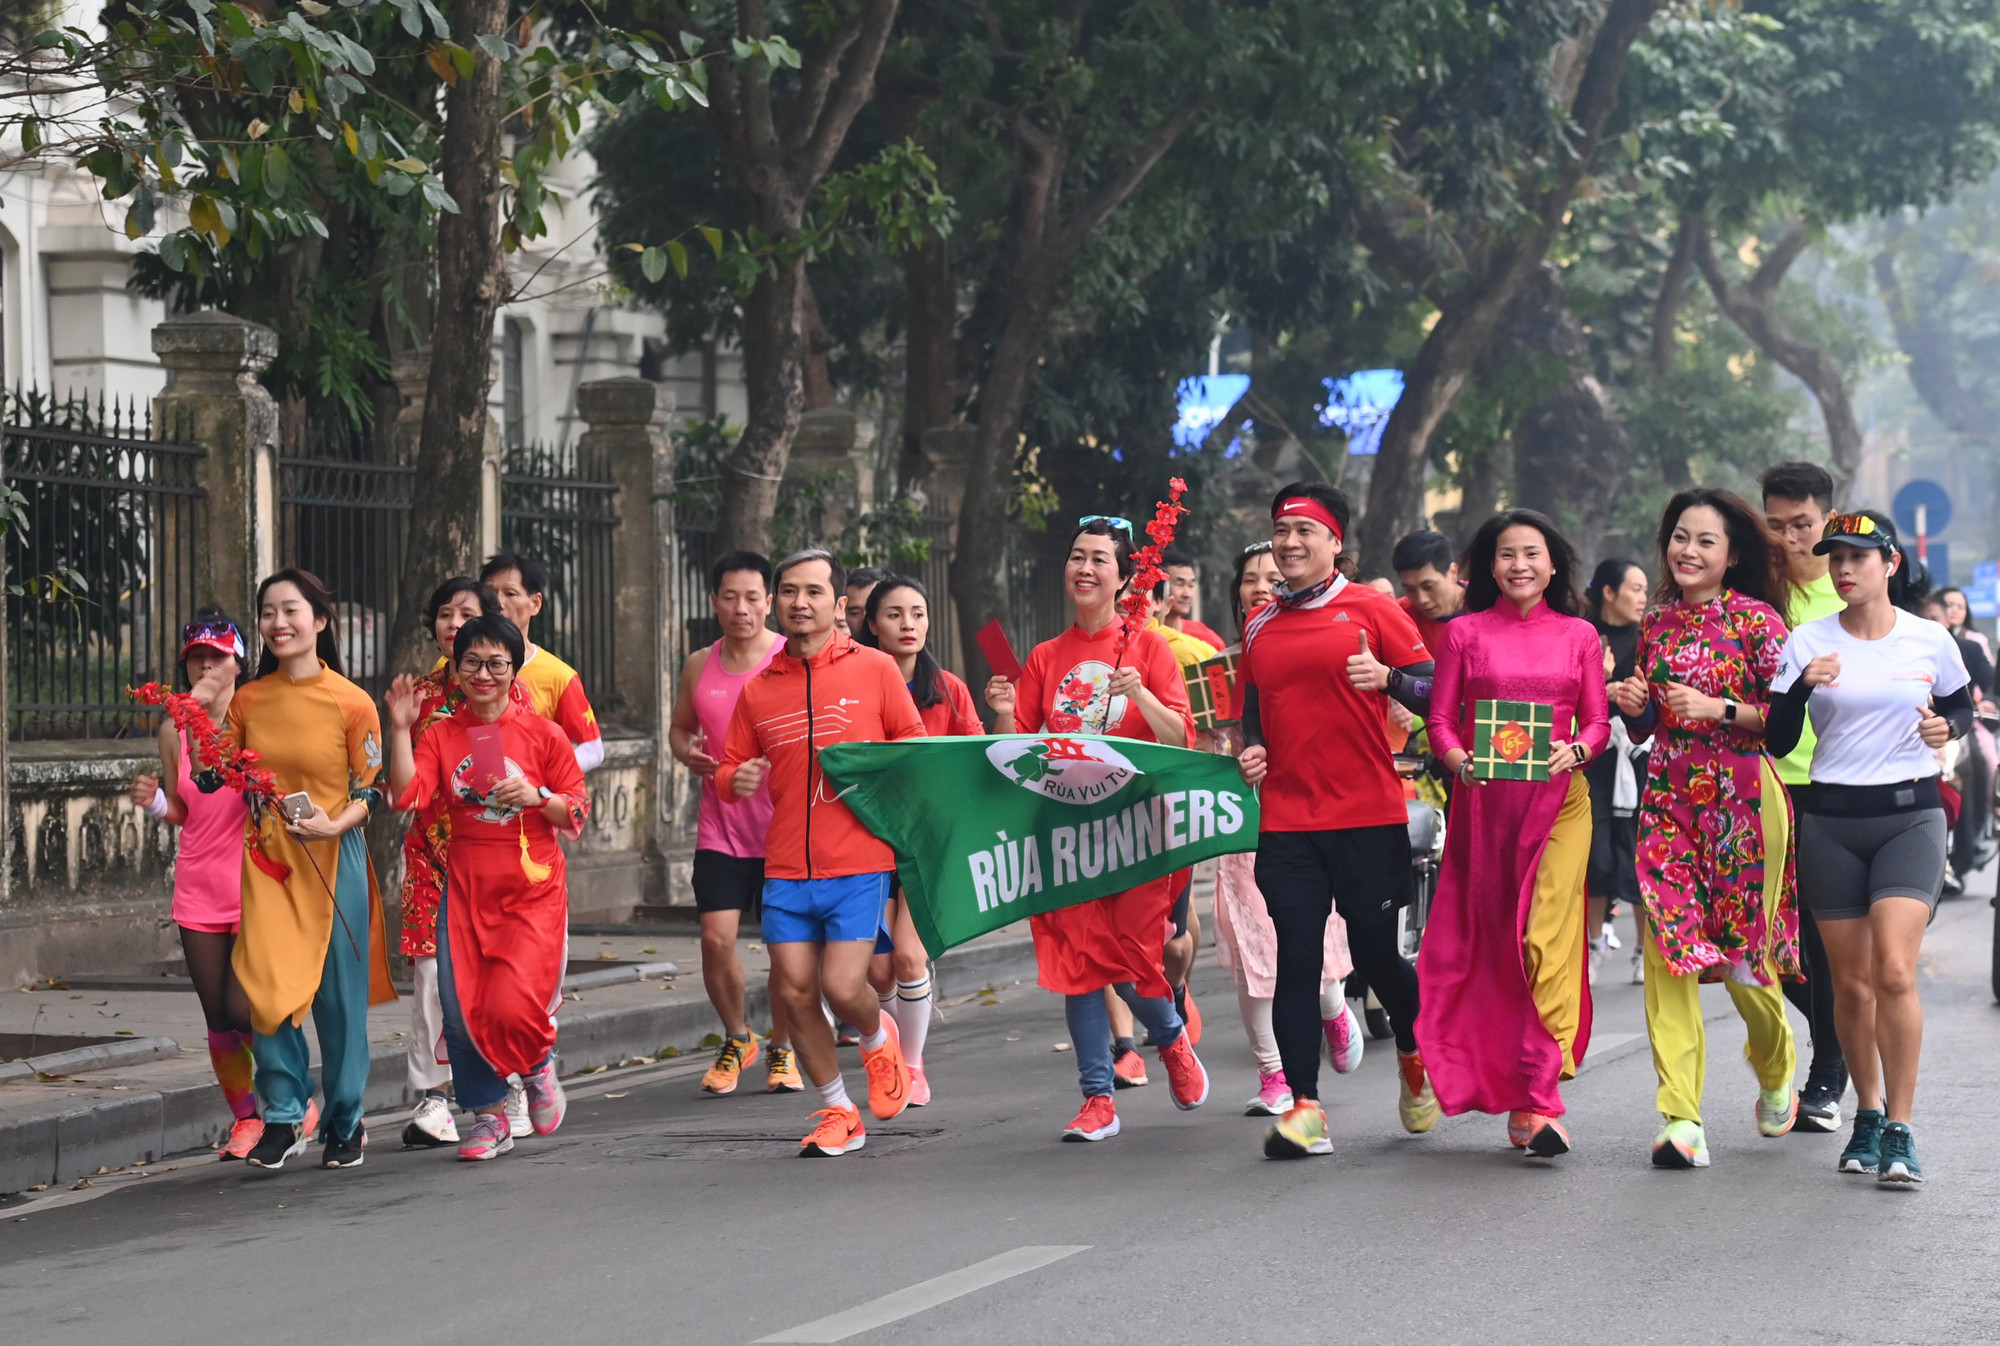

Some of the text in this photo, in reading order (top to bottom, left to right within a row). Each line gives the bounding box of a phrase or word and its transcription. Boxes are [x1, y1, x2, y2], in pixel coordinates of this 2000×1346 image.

[1043, 780, 1076, 800] RÙA
[1078, 782, 1107, 800] VUI
[967, 789, 1244, 913] RÙA RUNNERS
